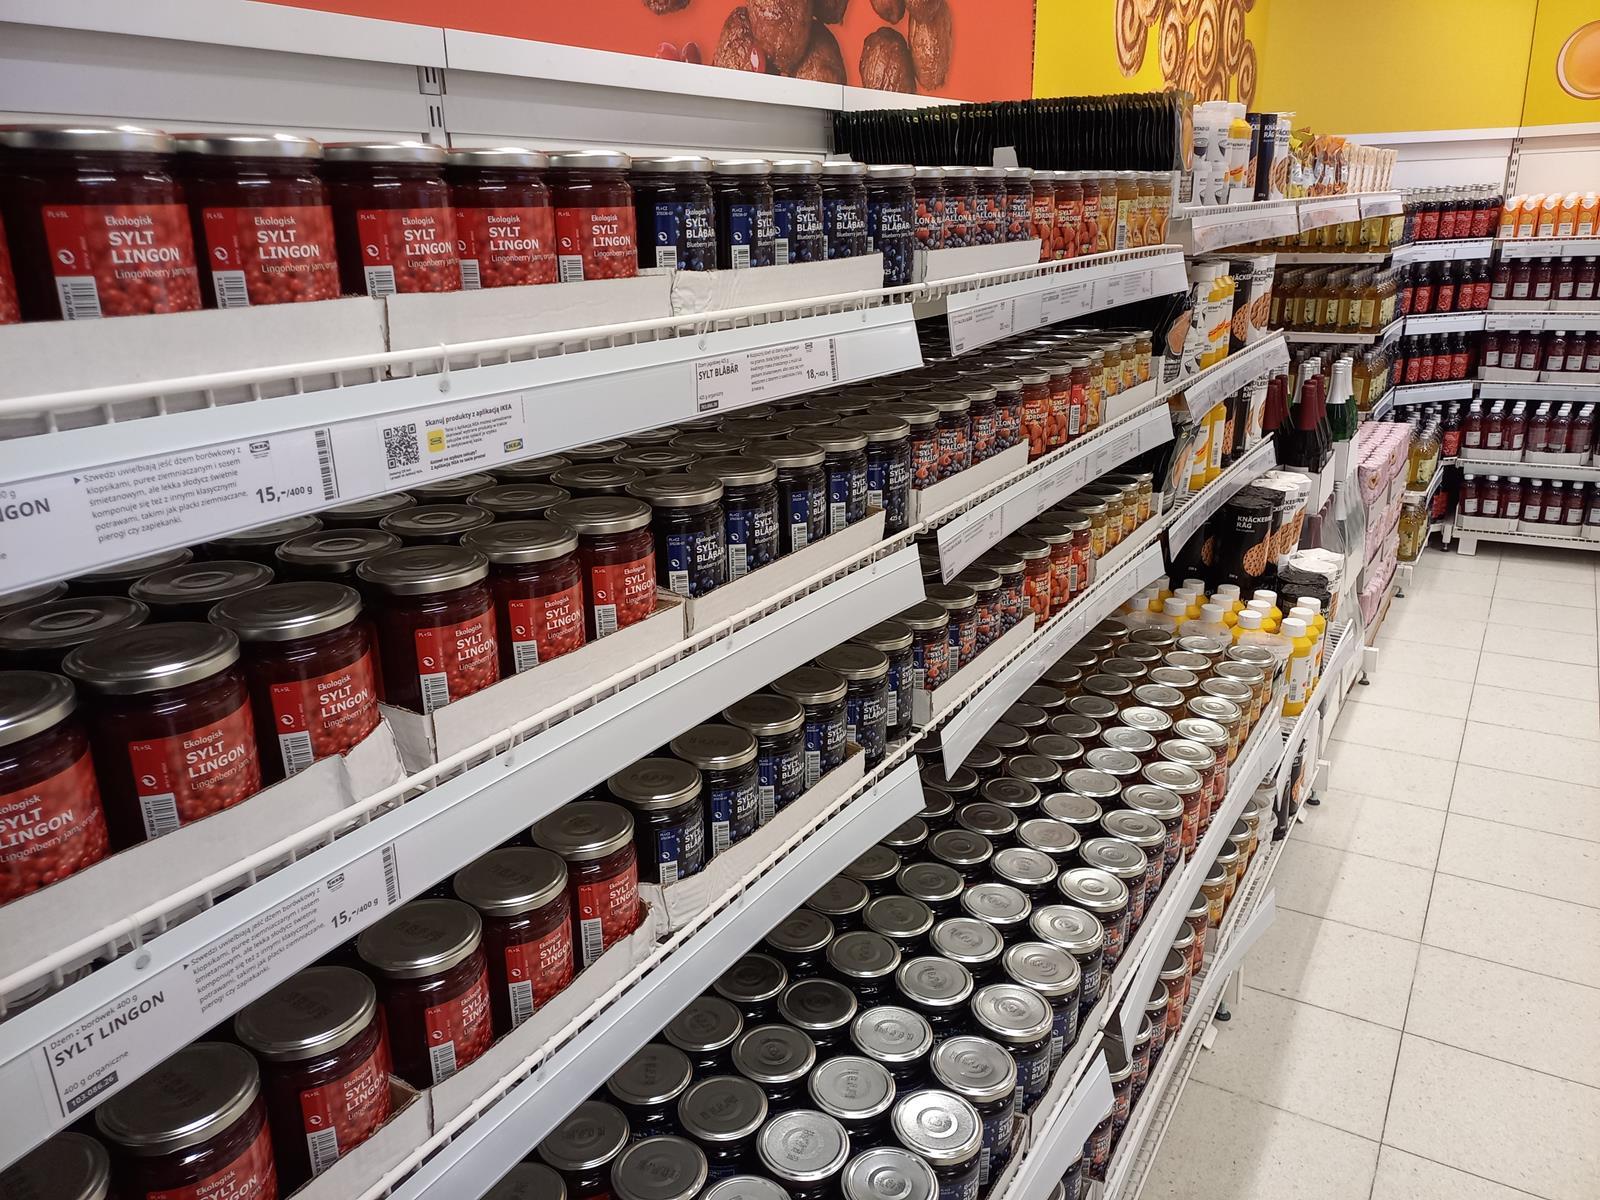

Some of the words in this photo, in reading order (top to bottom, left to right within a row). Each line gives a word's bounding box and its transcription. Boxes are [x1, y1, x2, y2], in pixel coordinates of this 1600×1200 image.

[105, 215, 153, 228] Ekologisk
[254, 216, 297, 227] Ekologisk
[402, 216, 436, 226] Ekologisk
[487, 215, 521, 225] Ekologisk
[591, 214, 618, 223] Ekologisk
[686, 217, 708, 228] SYLT
[797, 213, 816, 223] SYLT
[837, 212, 857, 222] SYLT
[881, 214, 901, 223] SYLT
[257, 229, 297, 244] SYLT
[404, 228, 436, 241] SYLT
[488, 226, 521, 238] SYLT
[592, 224, 618, 235] SYLT
[108, 230, 154, 246] SYLT
[490, 238, 539, 251] LINGON
[593, 235, 631, 247] LINGON
[111, 247, 180, 264] LINGON
[259, 244, 320, 260] LINGON
[405, 241, 453, 256] LINGON
[491, 254, 530, 265] Lingonberry
[115, 266, 171, 281] Lingonberry
[261, 262, 310, 276] Lingonberry
[698, 368, 714, 381] SYLT
[714, 362, 739, 377] BLÅBÄR
[425, 417, 445, 427] Skanuj
[445, 412, 472, 424] produkty
[476, 406, 499, 418] aplikacją
[500, 403, 512, 411] IKEA
[940, 437, 957, 446] SYLT
[306, 486, 313, 495] g
[754, 518, 773, 529] SYLT
[98, 530, 126, 543] pierogi
[127, 526, 139, 536] czy
[696, 541, 717, 554] SYLT
[624, 572, 646, 586] SYLT
[625, 577, 655, 596] LINGON
[545, 604, 570, 620] SYLT
[546, 610, 581, 630] LINGON
[455, 623, 482, 637] Ekologisk
[456, 633, 483, 649] SYLT
[457, 637, 495, 661] LINGON
[317, 674, 352, 691] Ekologisk
[320, 685, 352, 705] SYLT
[321, 688, 369, 718] LINGON
[863, 704, 880, 714] SYLT
[323, 709, 363, 729] Lingonberry
[183, 729, 224, 749] Ekologisk
[186, 740, 225, 765] SYLT
[188, 743, 246, 778] LINGON
[781, 759, 799, 772] SYLT
[191, 766, 238, 790] Lingonberry
[737, 791, 754, 806] SYLT
[0, 807, 42, 834] SYLT
[0, 808, 74, 850] LINGON
[0, 836, 62, 863] Lingonberry
[609, 882, 630, 899] SYLT
[373, 897, 379, 906] g
[540, 939, 562, 960] SYLT
[541, 941, 571, 969] LINGON
[201, 995, 225, 1014] pierogi
[225, 987, 236, 998] czy
[462, 993, 483, 1017] SYLT
[463, 994, 490, 1027] LINGON
[50, 1032, 74, 1050] Dżem
[81, 1007, 116, 1032] borówek
[116, 997, 131, 1010] 400
[132, 994, 138, 1003] g
[54, 1032, 95, 1067] SYLT
[99, 990, 165, 1040] LINGON
[63, 1082, 79, 1096] 400
[80, 1078, 86, 1087] g
[87, 1050, 129, 1081] organiczne
[343, 1066, 372, 1089] Ekologisk
[345, 1075, 373, 1100] SYLT
[346, 1070, 384, 1112] LINGON
[195, 1169, 236, 1196] Ekologisk
